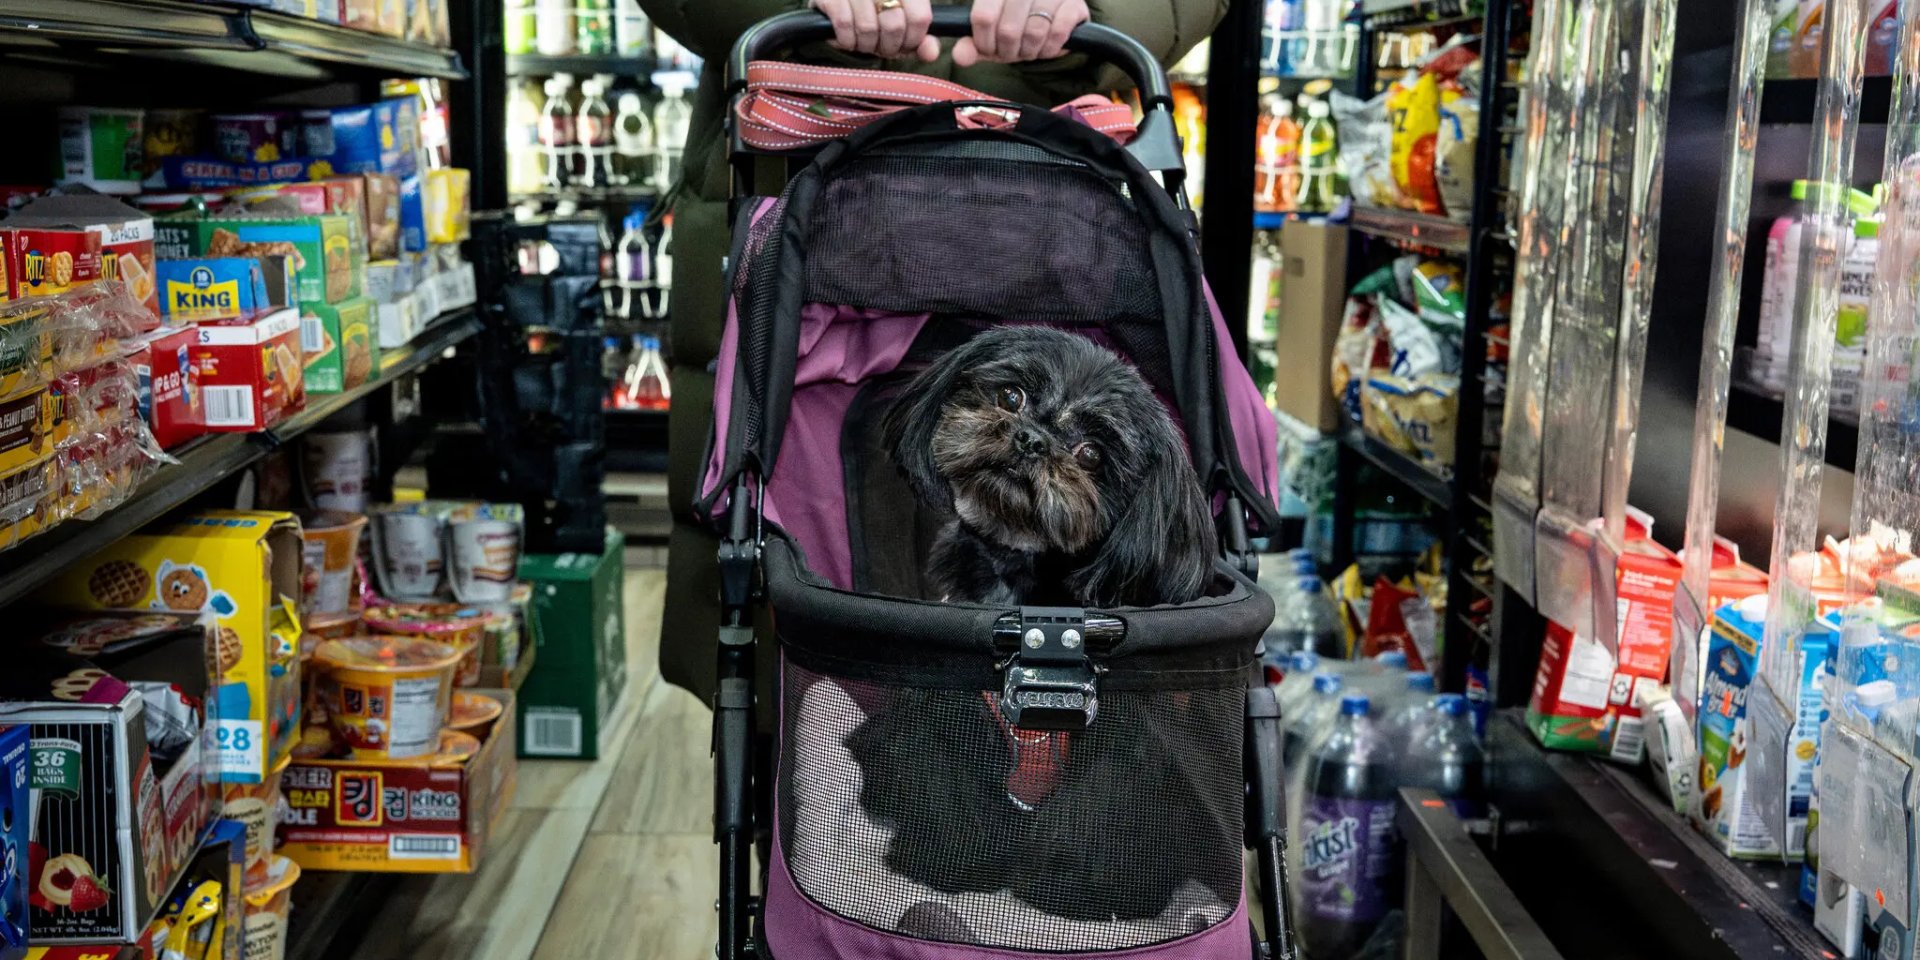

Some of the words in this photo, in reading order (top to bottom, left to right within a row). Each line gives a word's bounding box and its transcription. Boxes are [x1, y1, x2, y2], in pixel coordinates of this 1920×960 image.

[119, 226, 140, 241] PACKS
[25, 253, 45, 281] RITZ
[176, 291, 231, 308] KING
[216, 727, 251, 751] 28
[33, 750, 67, 768] 36
[32, 775, 67, 785] INSIDE
[37, 767, 65, 776] BAGS
[282, 766, 333, 789] STER
[344, 777, 375, 820] 킹
[411, 788, 459, 807] KING
